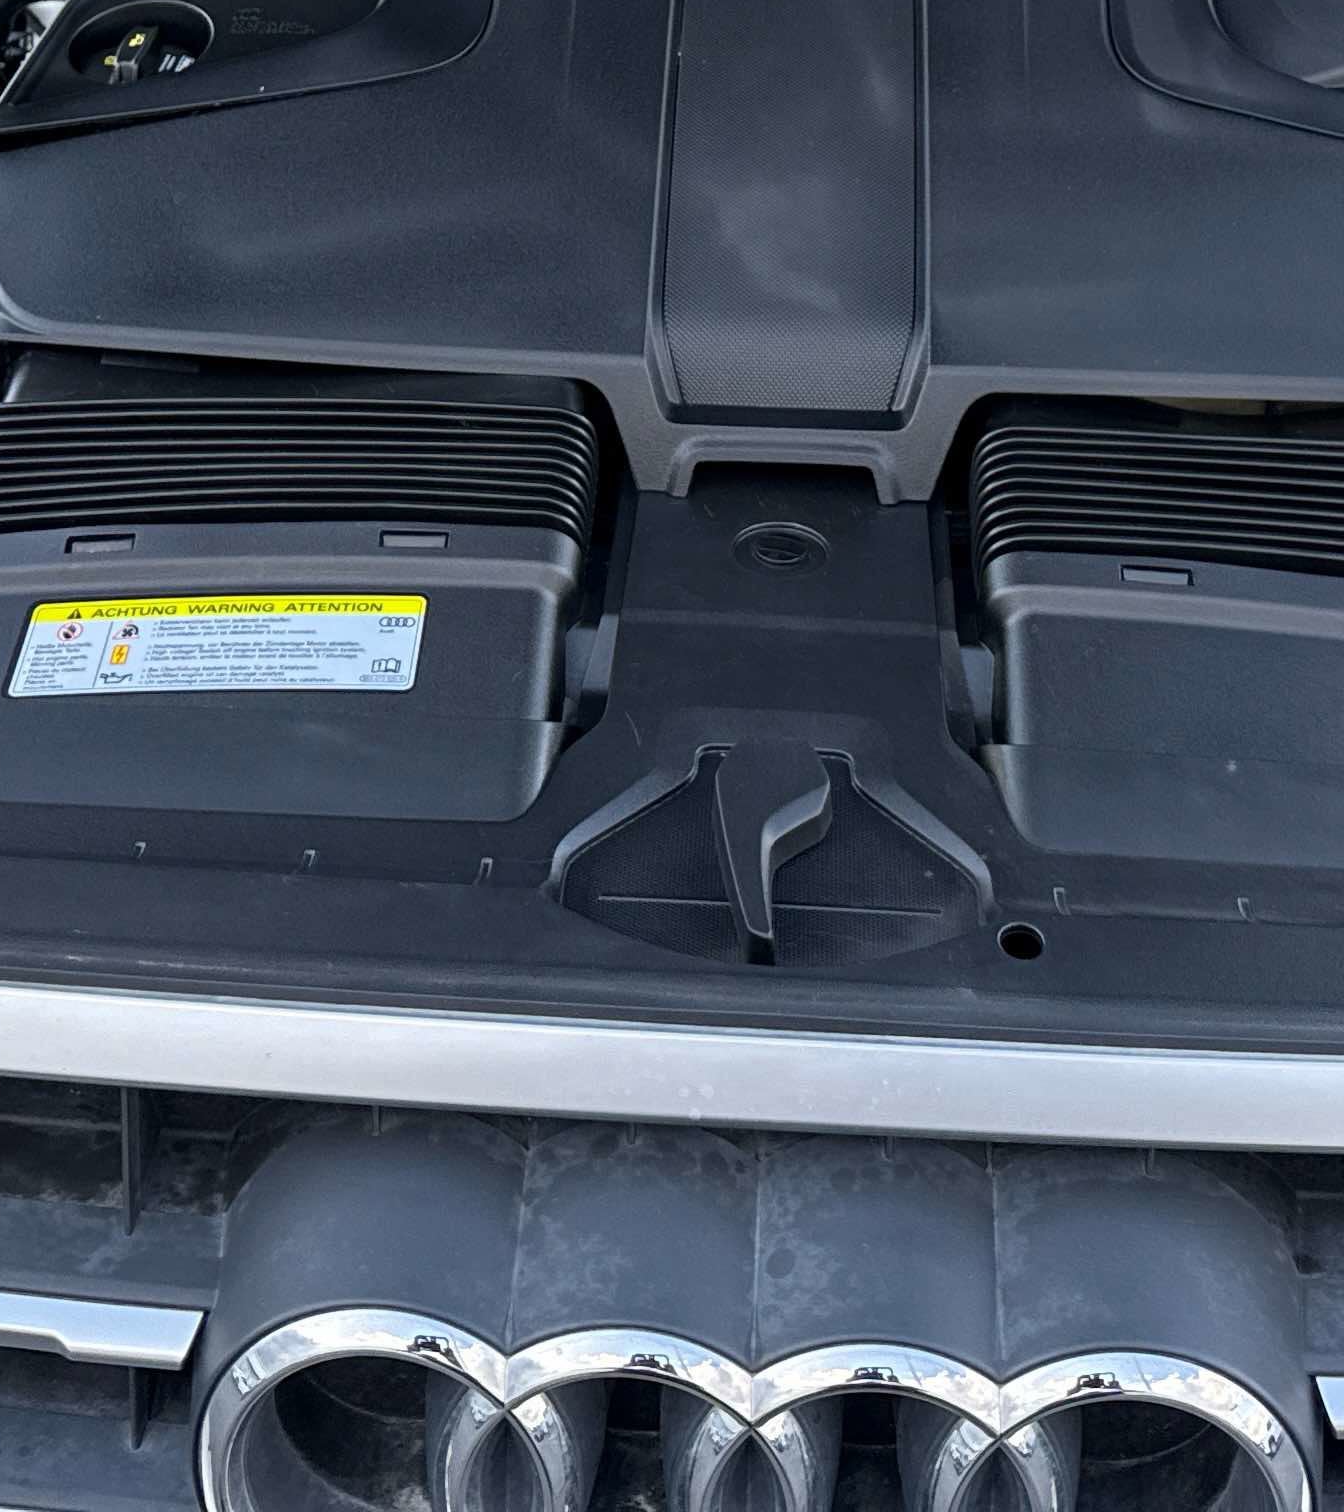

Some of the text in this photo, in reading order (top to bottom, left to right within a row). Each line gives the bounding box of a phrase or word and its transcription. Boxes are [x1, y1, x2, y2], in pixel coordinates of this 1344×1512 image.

[91, 602, 384, 619] ACHTUNG WARNING ATTENTION
